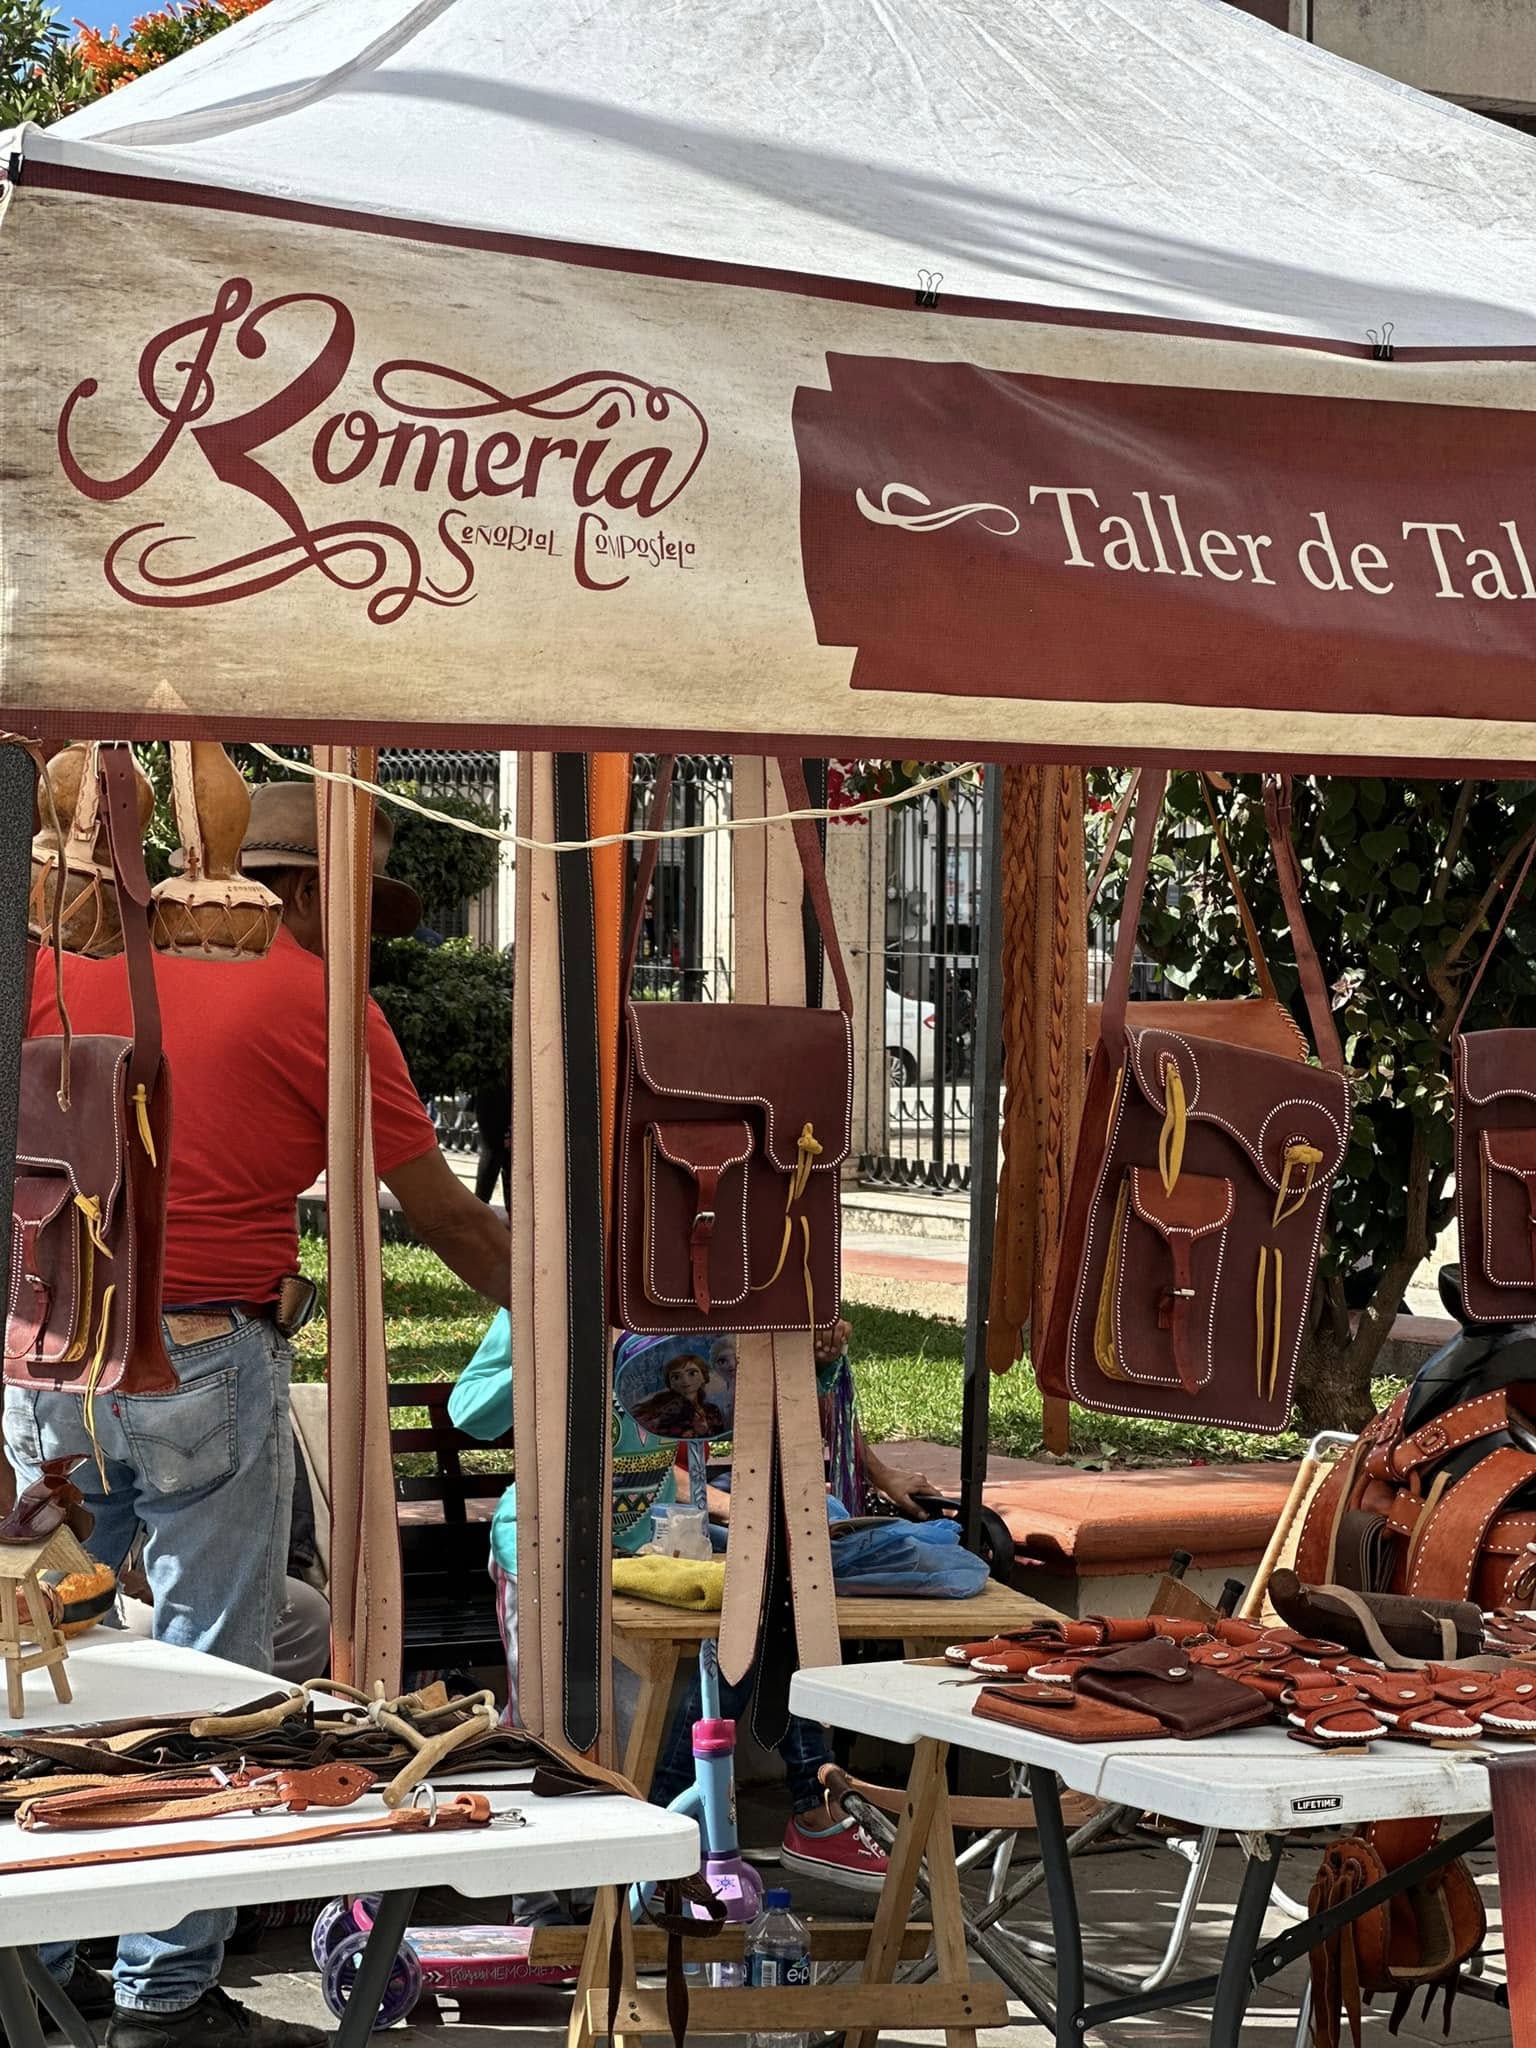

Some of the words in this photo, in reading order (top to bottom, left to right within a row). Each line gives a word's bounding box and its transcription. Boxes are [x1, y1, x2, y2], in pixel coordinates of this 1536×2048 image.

[1029, 486, 1277, 586] Taller
[1299, 511, 1395, 595] de
[1297, 1798, 1337, 1810] LIFETIME
